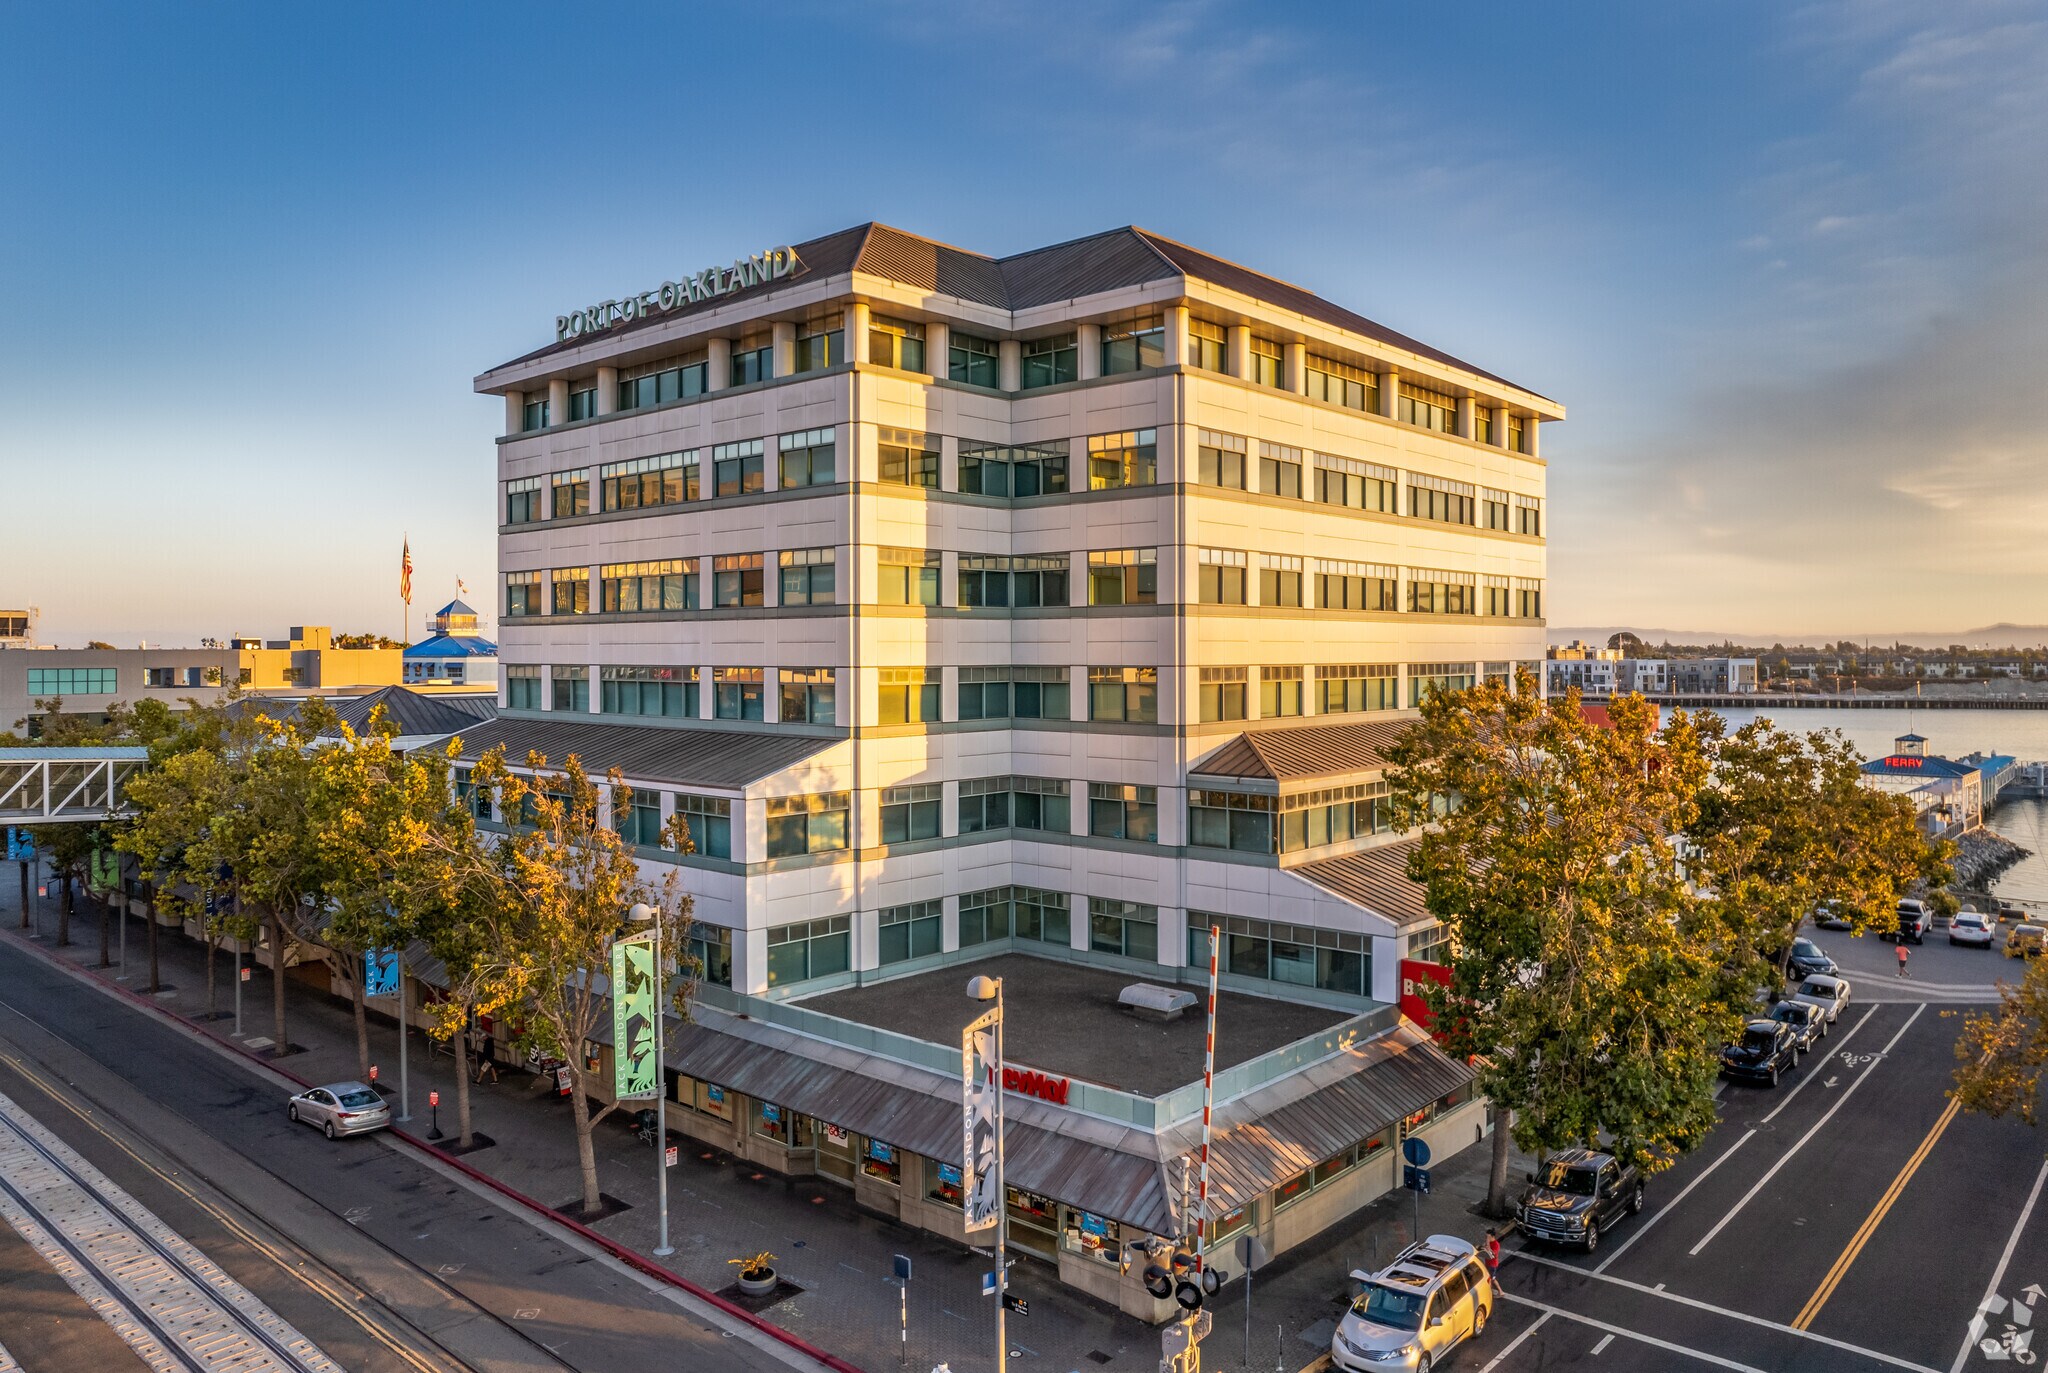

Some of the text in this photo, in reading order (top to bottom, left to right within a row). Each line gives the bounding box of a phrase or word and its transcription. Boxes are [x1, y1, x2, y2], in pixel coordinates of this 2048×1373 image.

[556, 245, 797, 342] PORT OF OAKLAND
[1885, 757, 1923, 768] FERRY
[615, 944, 626, 1095] JACK LONDON SQUARE
[965, 1105, 973, 1178] LONDON
